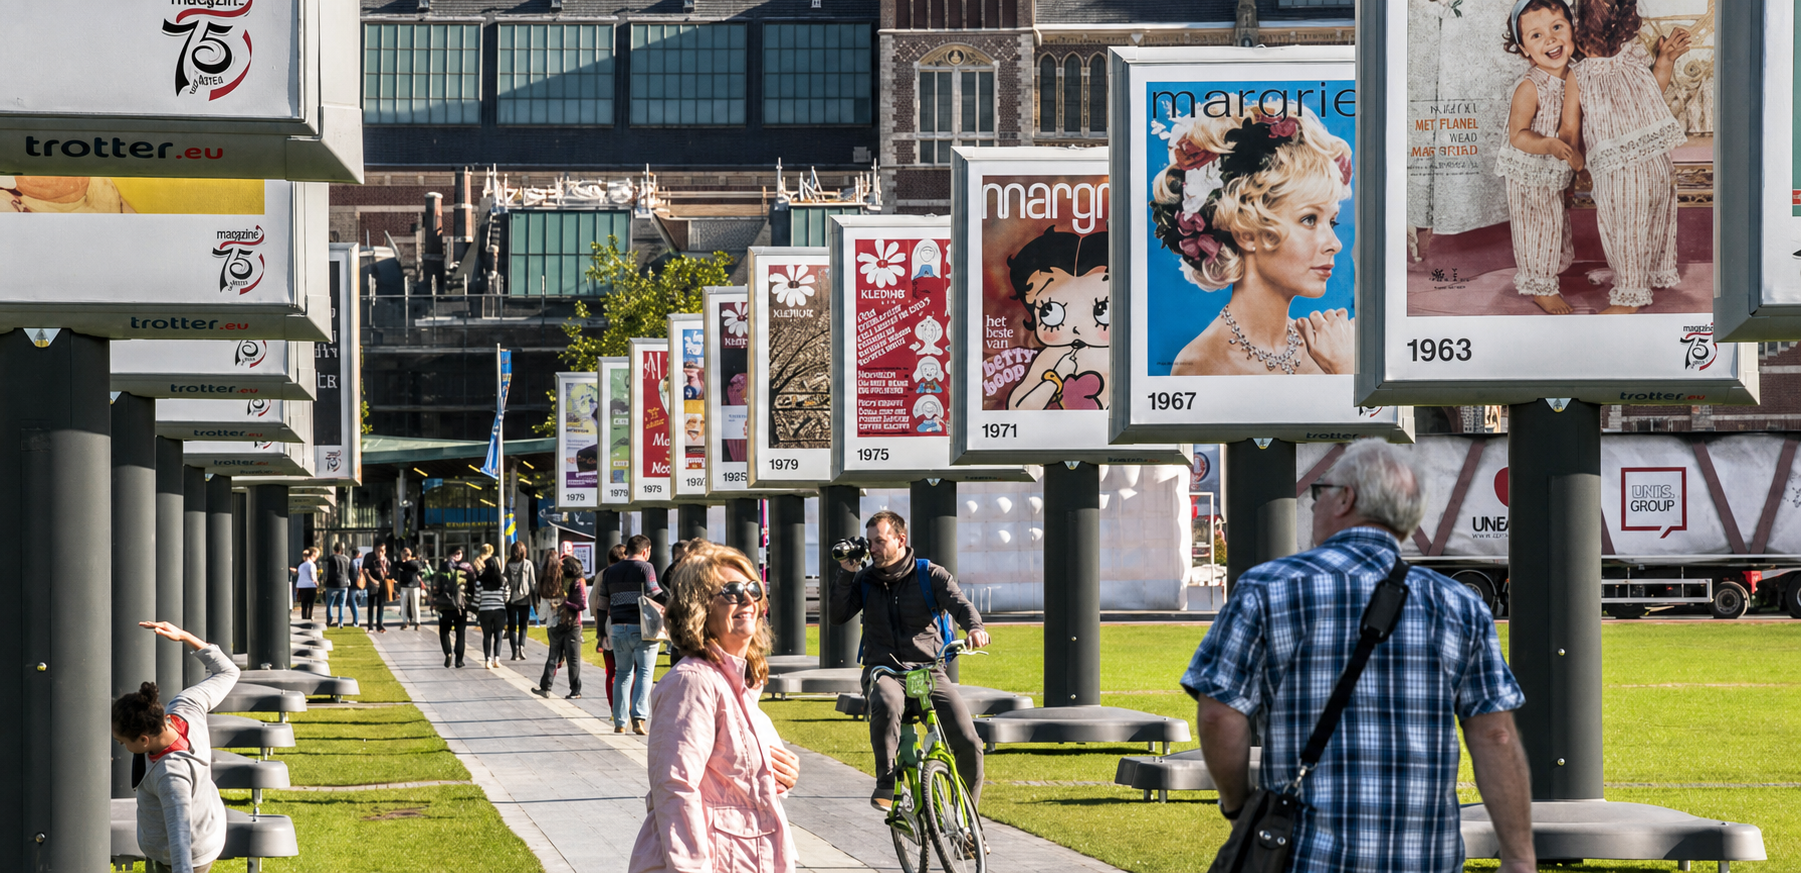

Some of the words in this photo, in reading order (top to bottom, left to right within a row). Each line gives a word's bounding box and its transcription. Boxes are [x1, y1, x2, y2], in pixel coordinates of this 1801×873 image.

[161, 18, 233, 97] 75
[1415, 119, 1437, 132] MET
[1439, 118, 1479, 130] FLANEL
[25, 136, 224, 160] trotter.eu
[216, 229, 259, 241] magazine
[212, 247, 253, 293] 75
[130, 316, 249, 331] trotter.eu
[986, 314, 1007, 327] het
[986, 339, 1009, 349] van
[1406, 338, 1473, 362] 1963
[1680, 337, 1709, 370] 75
[982, 364, 1025, 397] boop
[170, 383, 259, 394] trotter.eu
[1147, 392, 1197, 410] 1967
[1619, 391, 1706, 401] trotter.eu
[194, 429, 263, 438] trotter.eu
[981, 424, 1018, 438] 1971
[857, 448, 889, 462] 1975
[768, 459, 799, 470] 1979
[566, 493, 586, 502] 1979
[610, 489, 629, 497] 1979
[1630, 500, 1675, 512] GROUP
